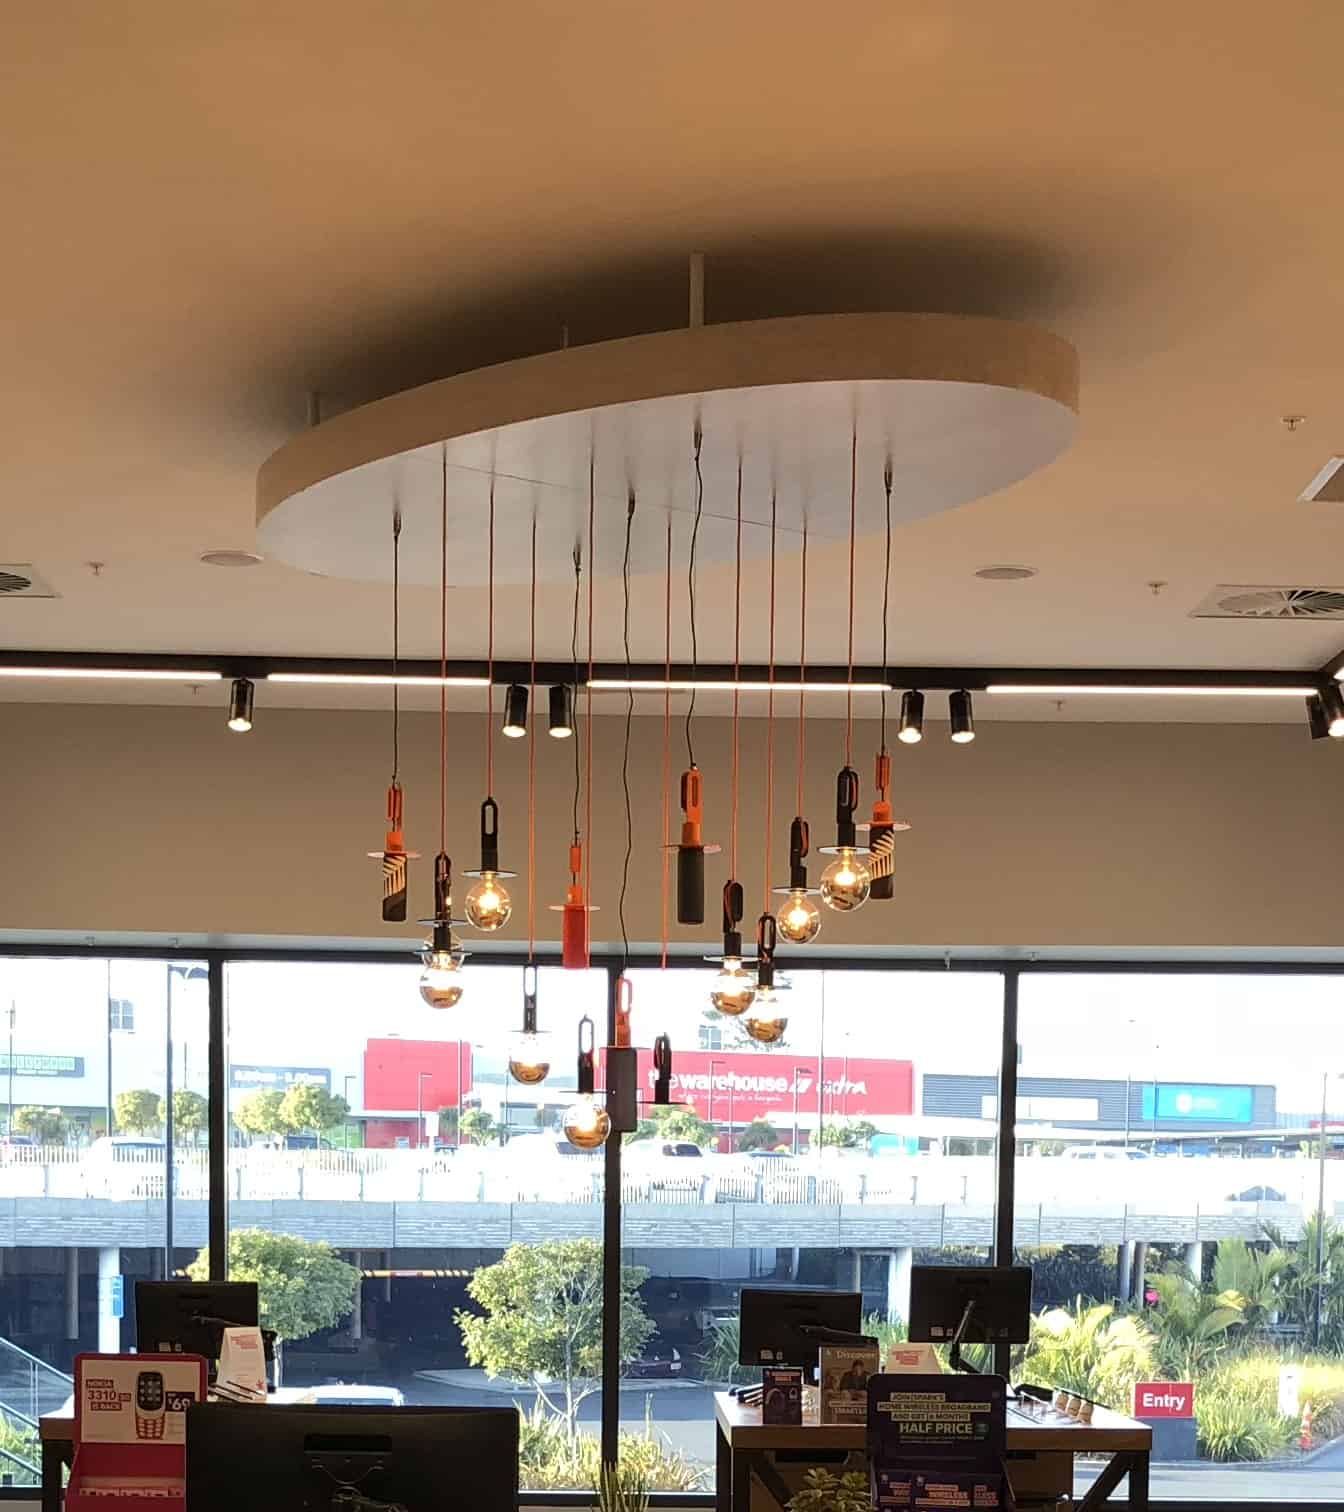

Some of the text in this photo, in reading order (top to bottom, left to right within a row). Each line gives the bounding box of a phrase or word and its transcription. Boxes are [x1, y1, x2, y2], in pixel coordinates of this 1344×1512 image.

[648, 1069, 679, 1090] te
[679, 1071, 789, 1094] warehouse
[88, 1390, 117, 1401] 3310
[1142, 1392, 1186, 1411] Entry
[900, 1422, 973, 1433] HALF PRICE
